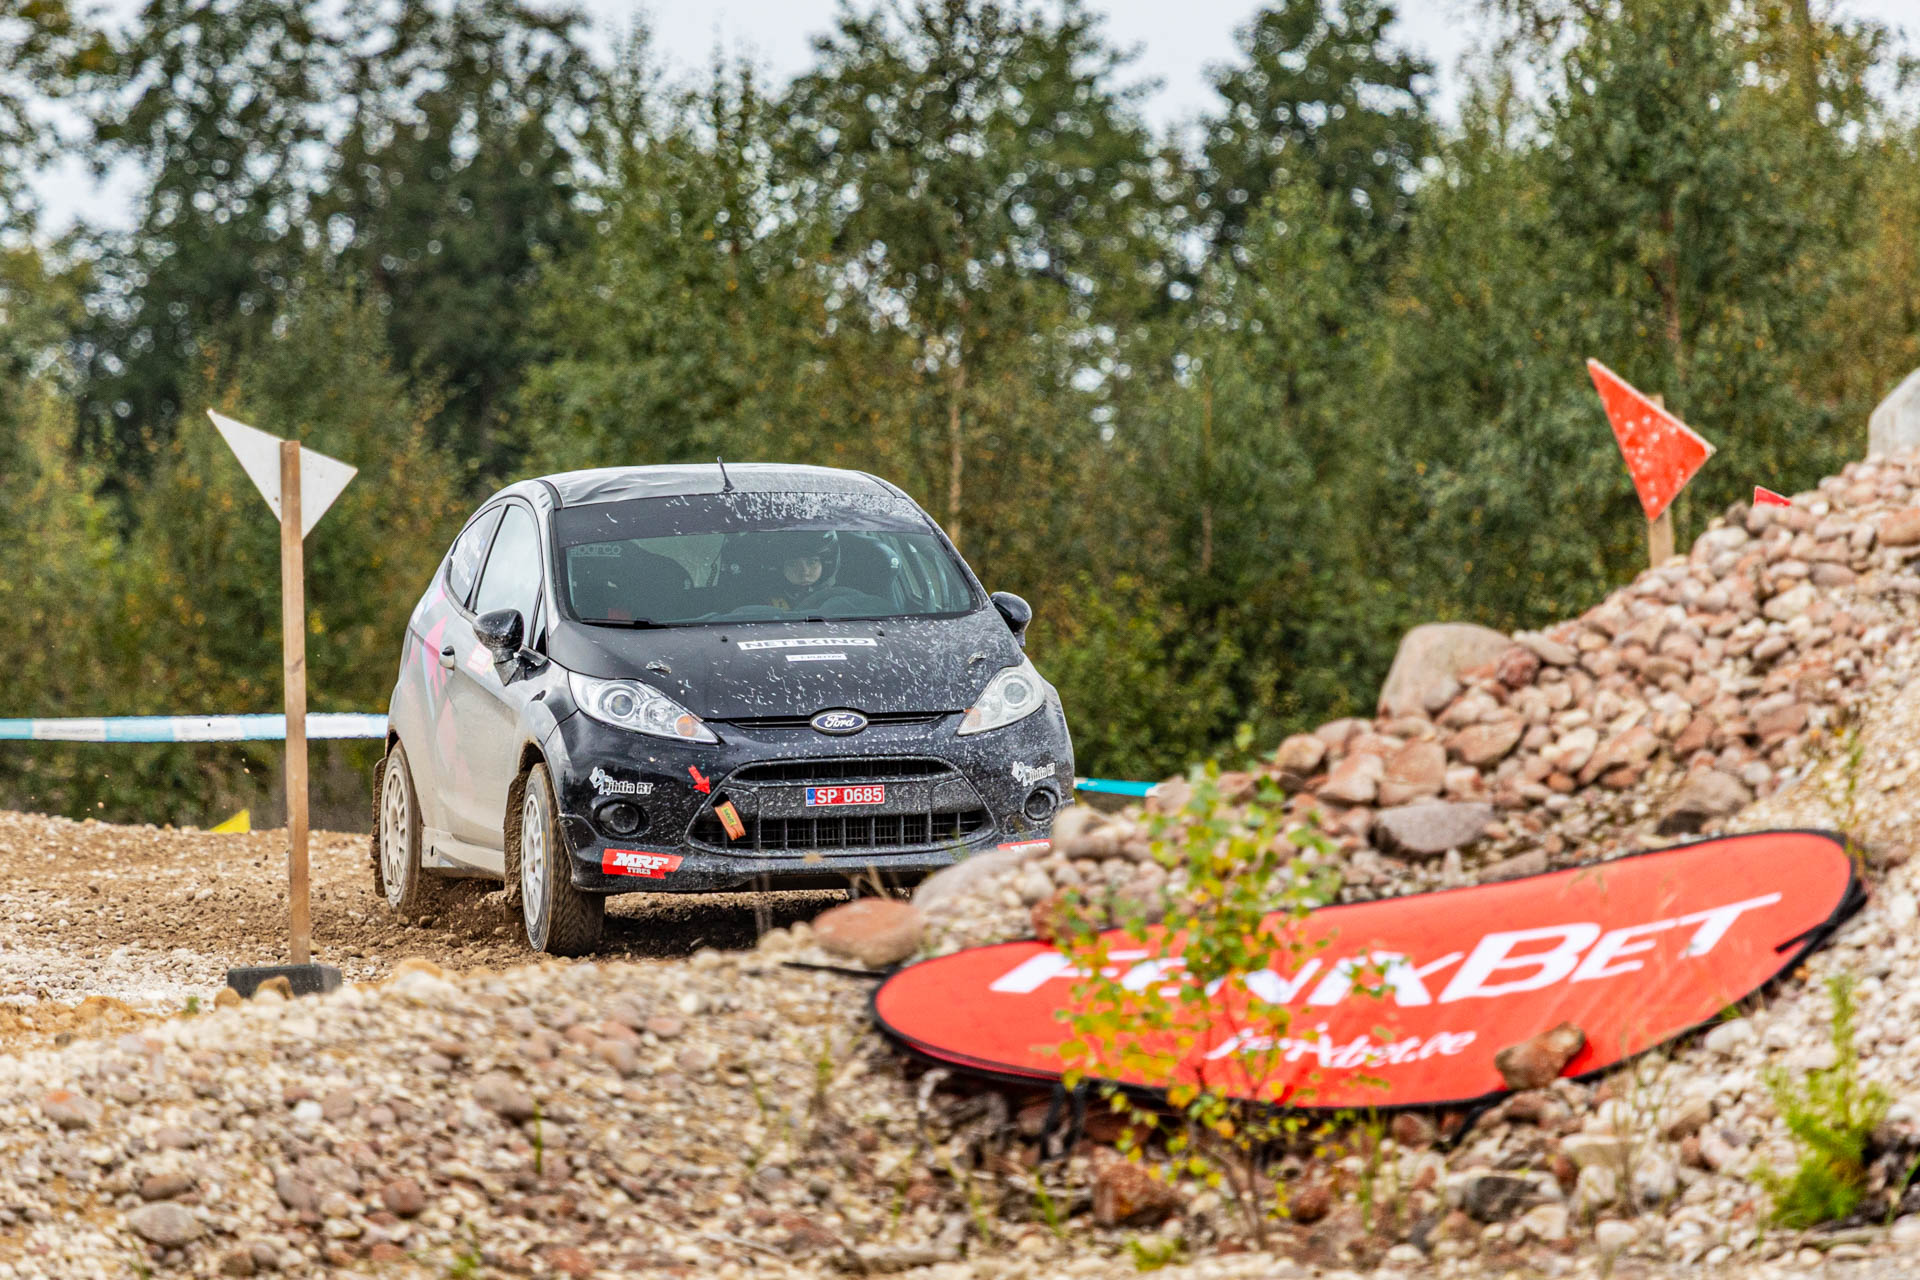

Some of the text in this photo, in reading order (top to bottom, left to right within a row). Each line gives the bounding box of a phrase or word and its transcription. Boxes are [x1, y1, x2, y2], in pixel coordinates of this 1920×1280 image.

[824, 713, 855, 728] Ford
[816, 787, 882, 804] SP 0685
[612, 852, 669, 870] MRF
[626, 867, 651, 875] TYRES
